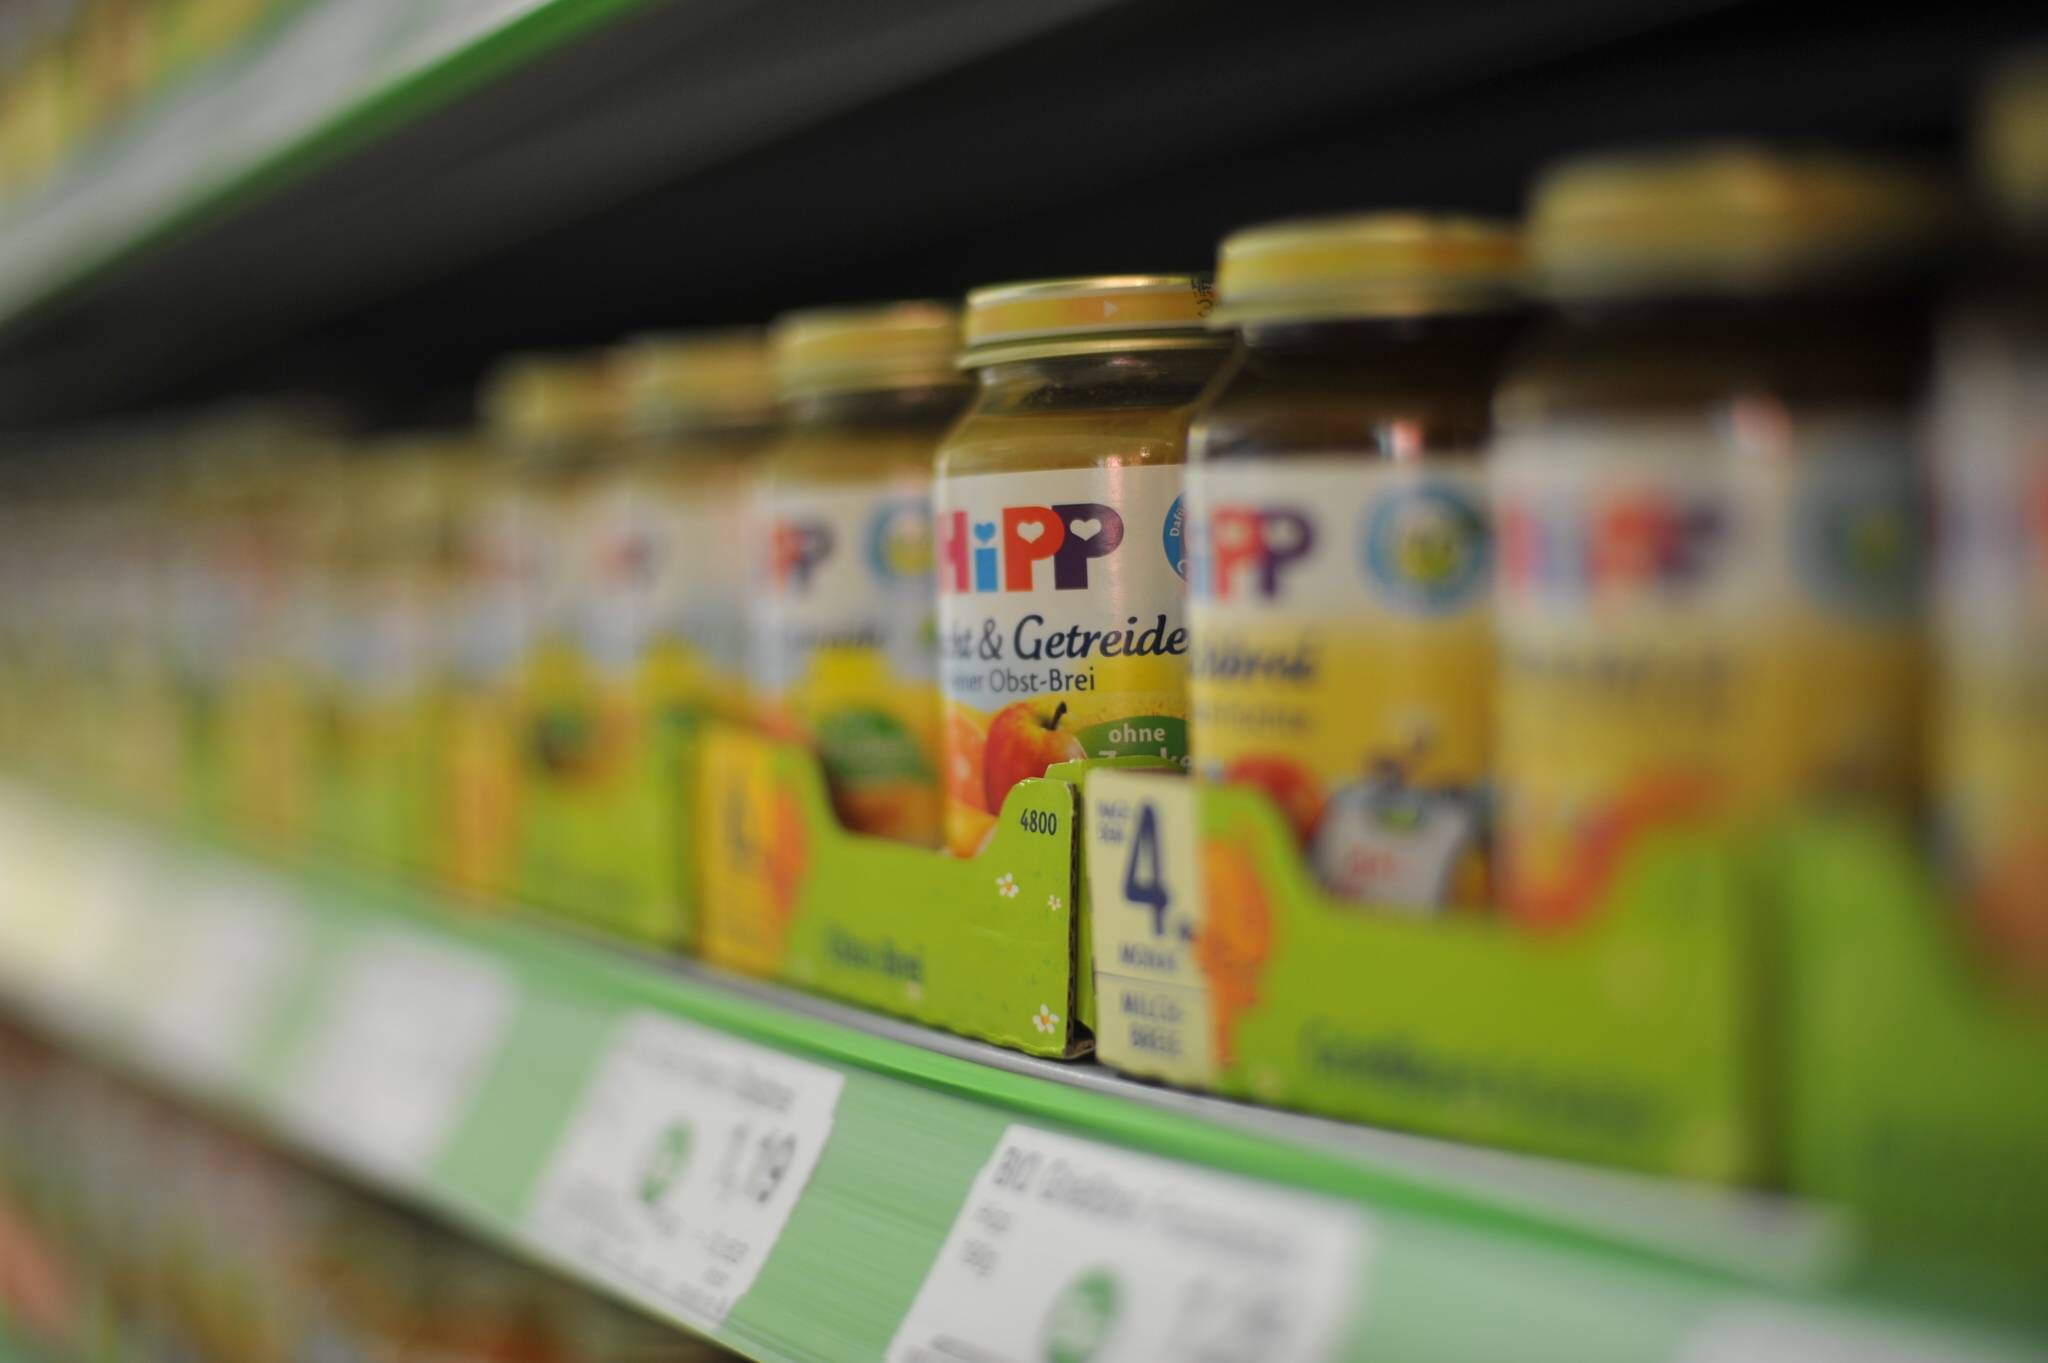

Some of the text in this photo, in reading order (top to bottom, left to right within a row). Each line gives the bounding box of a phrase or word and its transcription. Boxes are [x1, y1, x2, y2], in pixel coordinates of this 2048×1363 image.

[937, 503, 1125, 593] HiPP
[979, 617, 1002, 660] &
[1014, 614, 1189, 660] Getreide
[989, 667, 1095, 692] Obst-Brei
[1108, 722, 1166, 743] ohne
[1021, 808, 1057, 836] 4800
